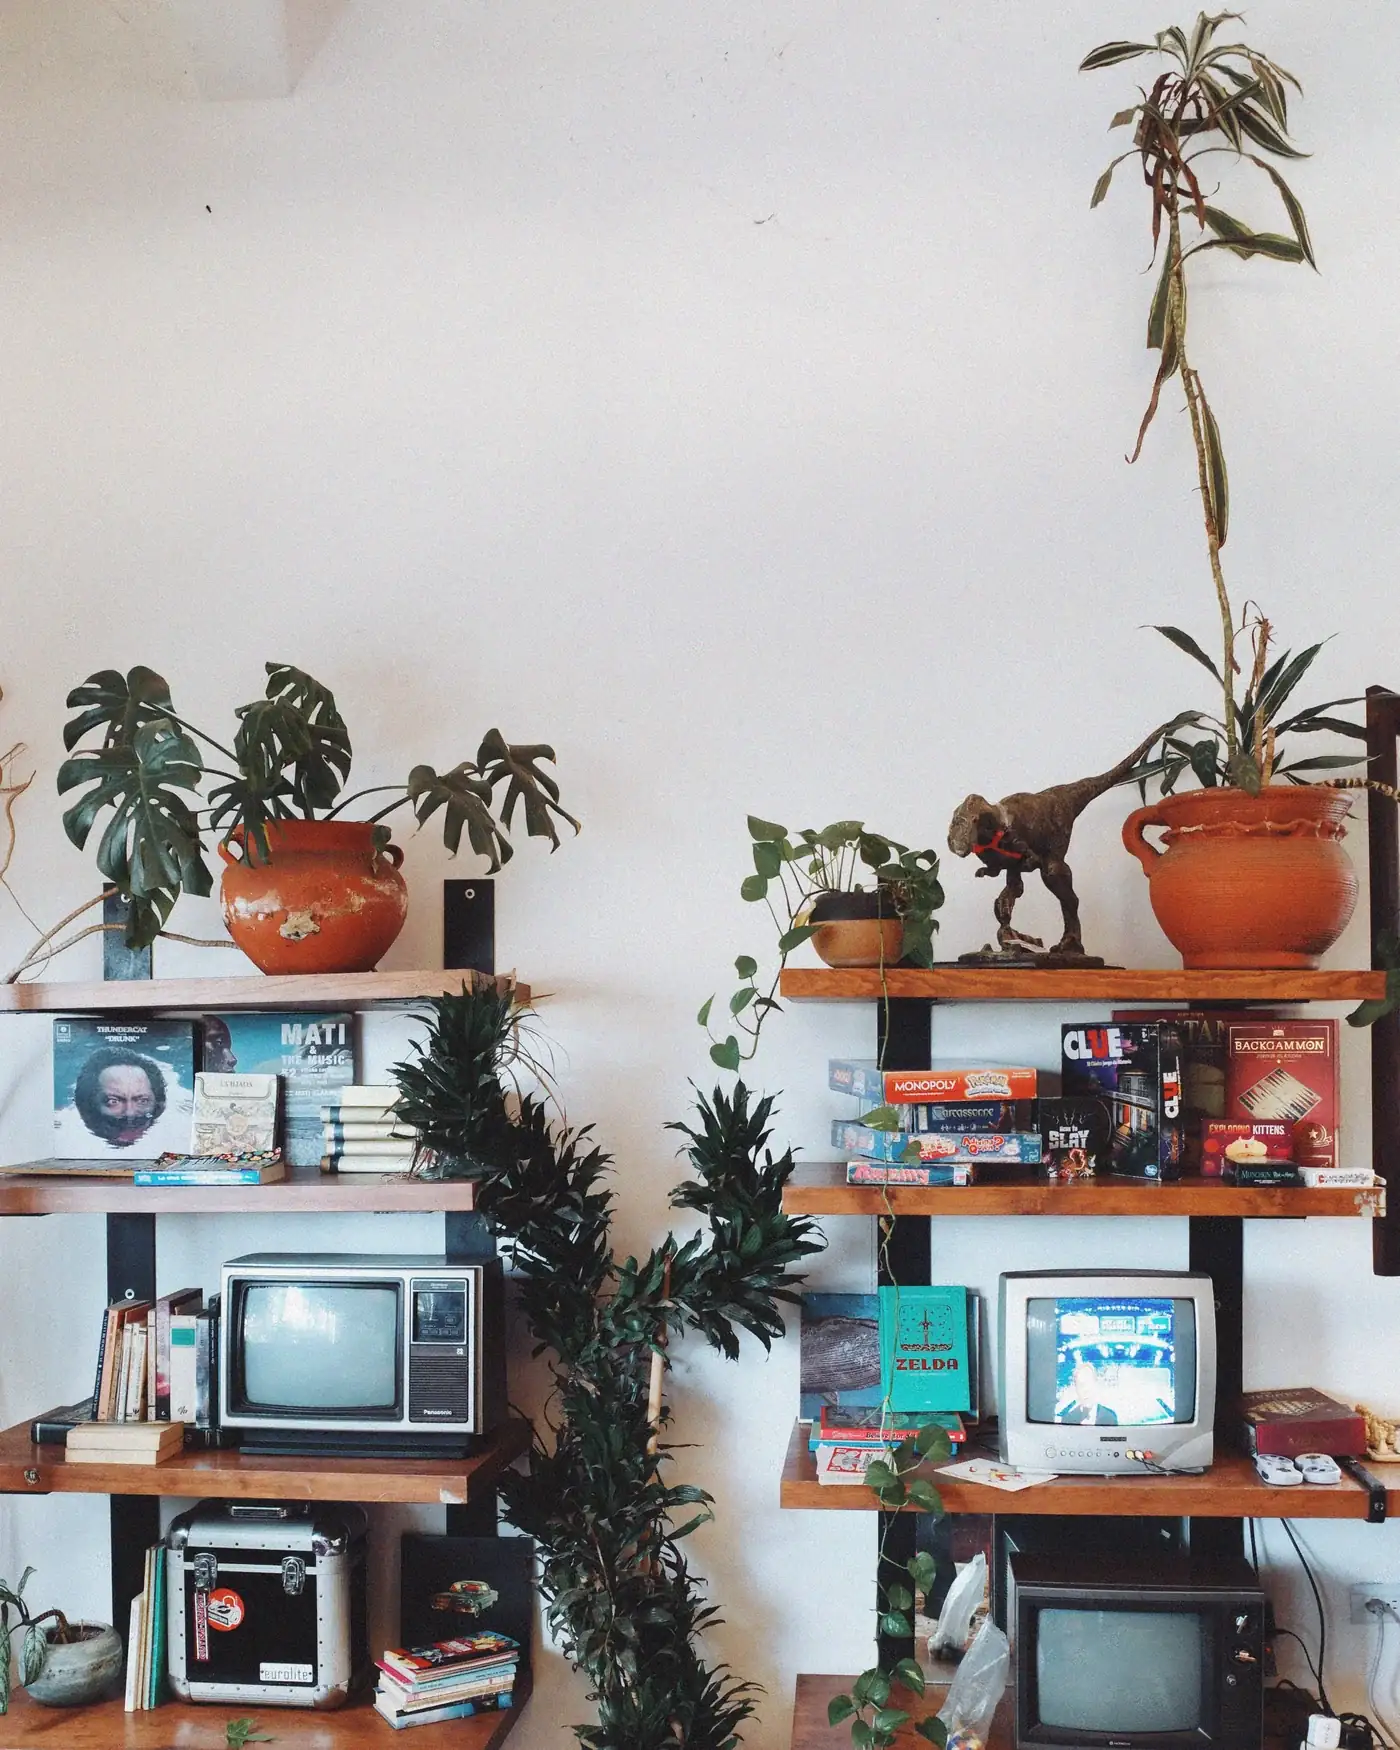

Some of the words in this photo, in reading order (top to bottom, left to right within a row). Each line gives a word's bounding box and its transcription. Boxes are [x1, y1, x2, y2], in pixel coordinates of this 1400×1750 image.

[281, 1024, 345, 1045] MATI
[309, 1046, 316, 1054] &
[1064, 1028, 1124, 1060] CLUE
[1235, 1041, 1324, 1050] BACKGAMMON
[281, 1055, 302, 1064] THE
[307, 1055, 345, 1064] MUSIC
[895, 1079, 956, 1091] MONOPOLY
[1163, 1071, 1179, 1119] CLUE
[1252, 1124, 1285, 1135] KITTENS
[1049, 1130, 1090, 1149] SLAY
[896, 1358, 958, 1370] ZELDA
[265, 1667, 308, 1680] eurolite
